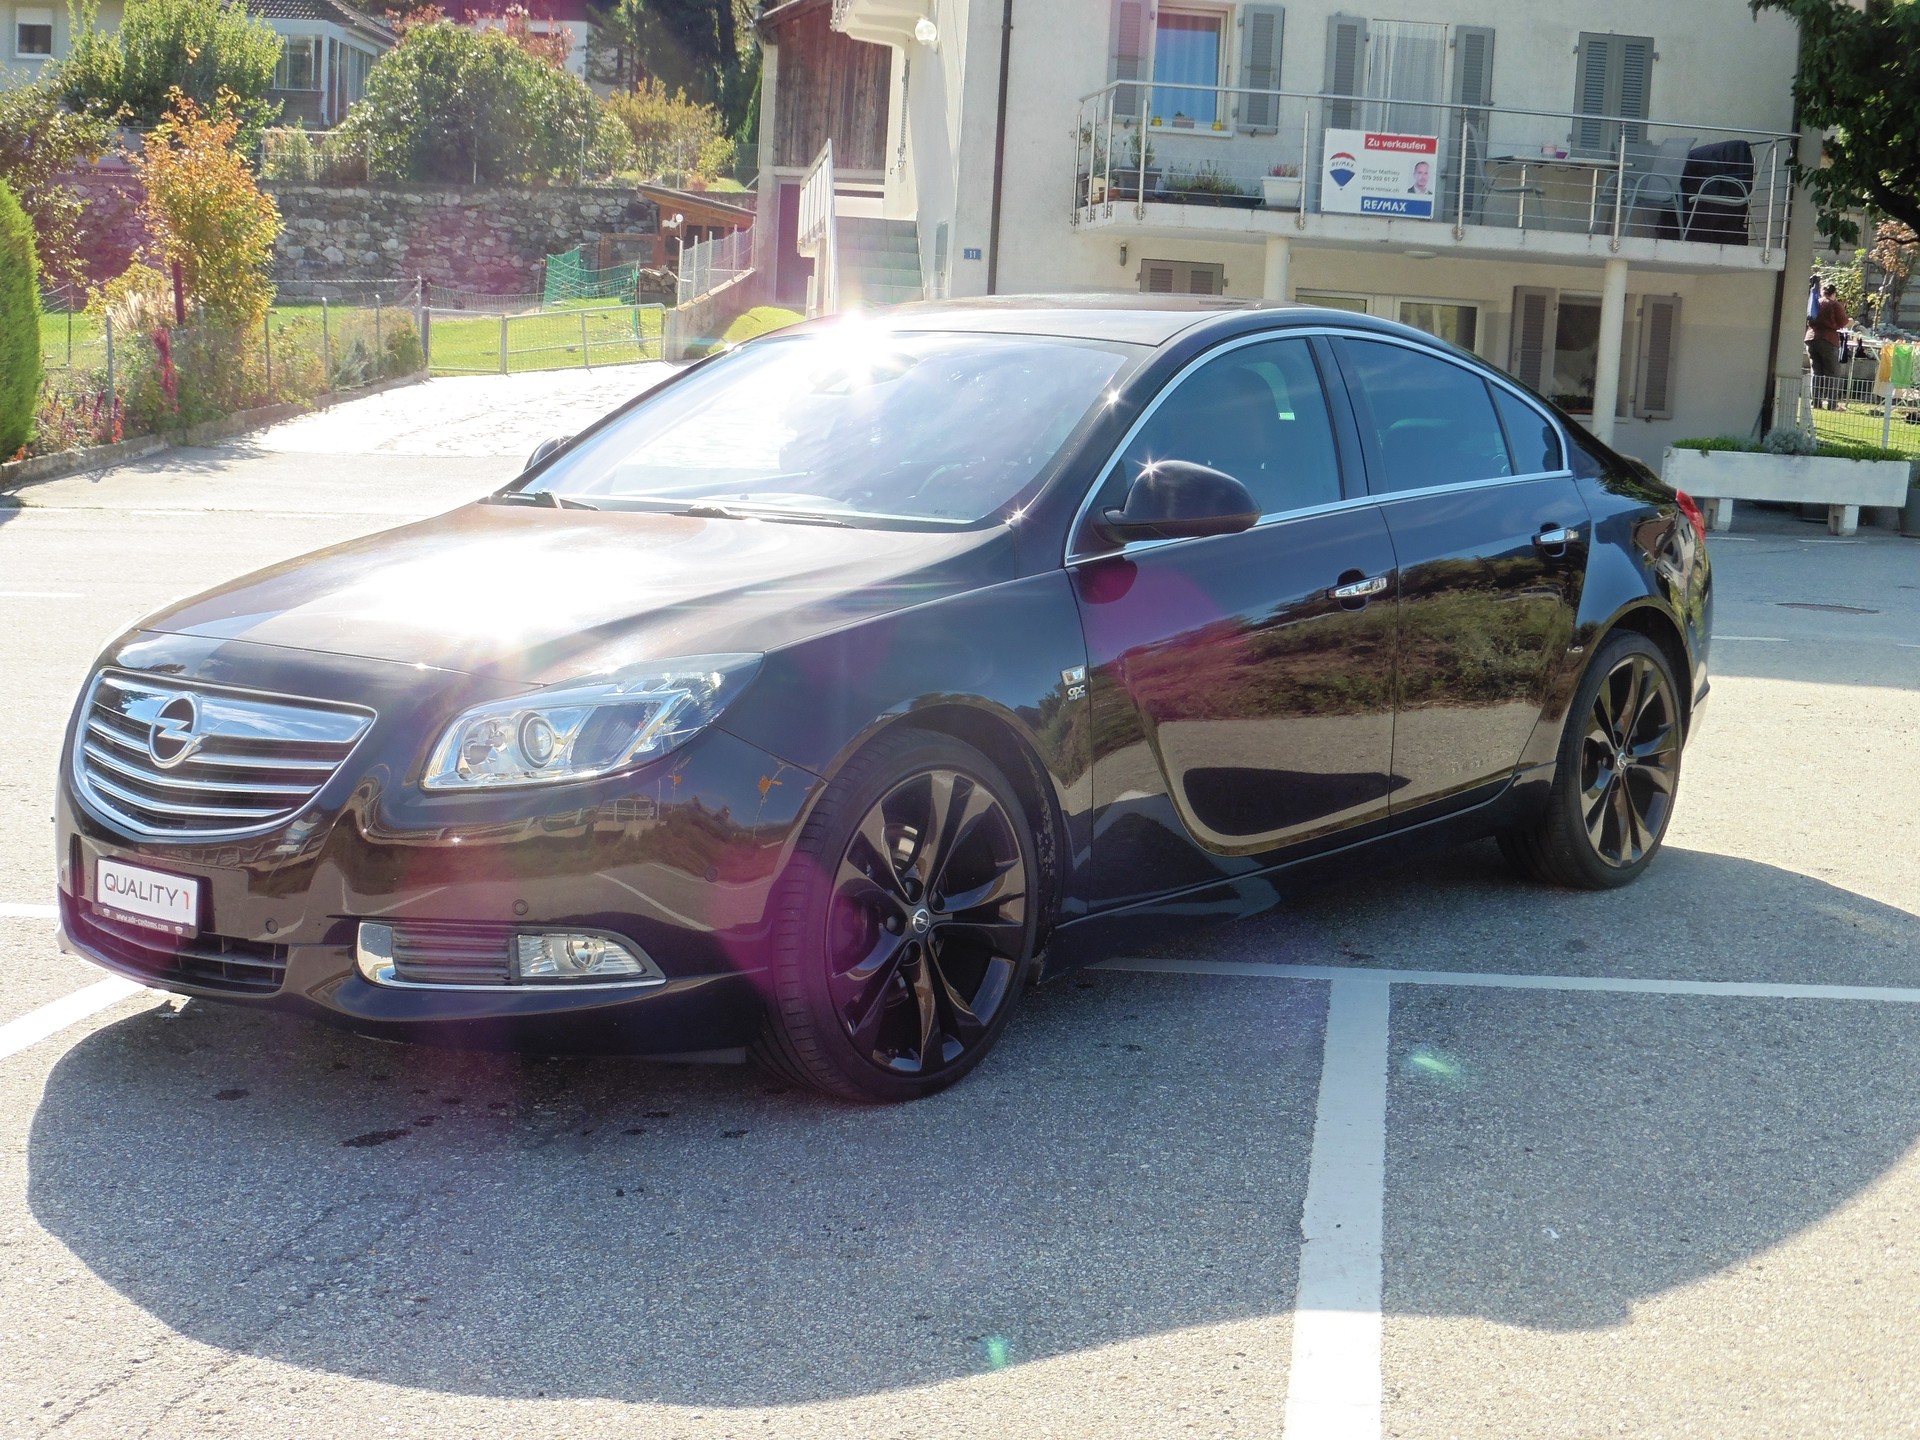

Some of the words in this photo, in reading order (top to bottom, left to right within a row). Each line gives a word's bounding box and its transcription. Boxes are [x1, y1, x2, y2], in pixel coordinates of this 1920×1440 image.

[1367, 137, 1380, 147] Zu
[1382, 139, 1427, 151] verkaufen
[1363, 199, 1408, 212] RE/MAX
[104, 872, 179, 907] QUALITY
[182, 890, 190, 910] 1
